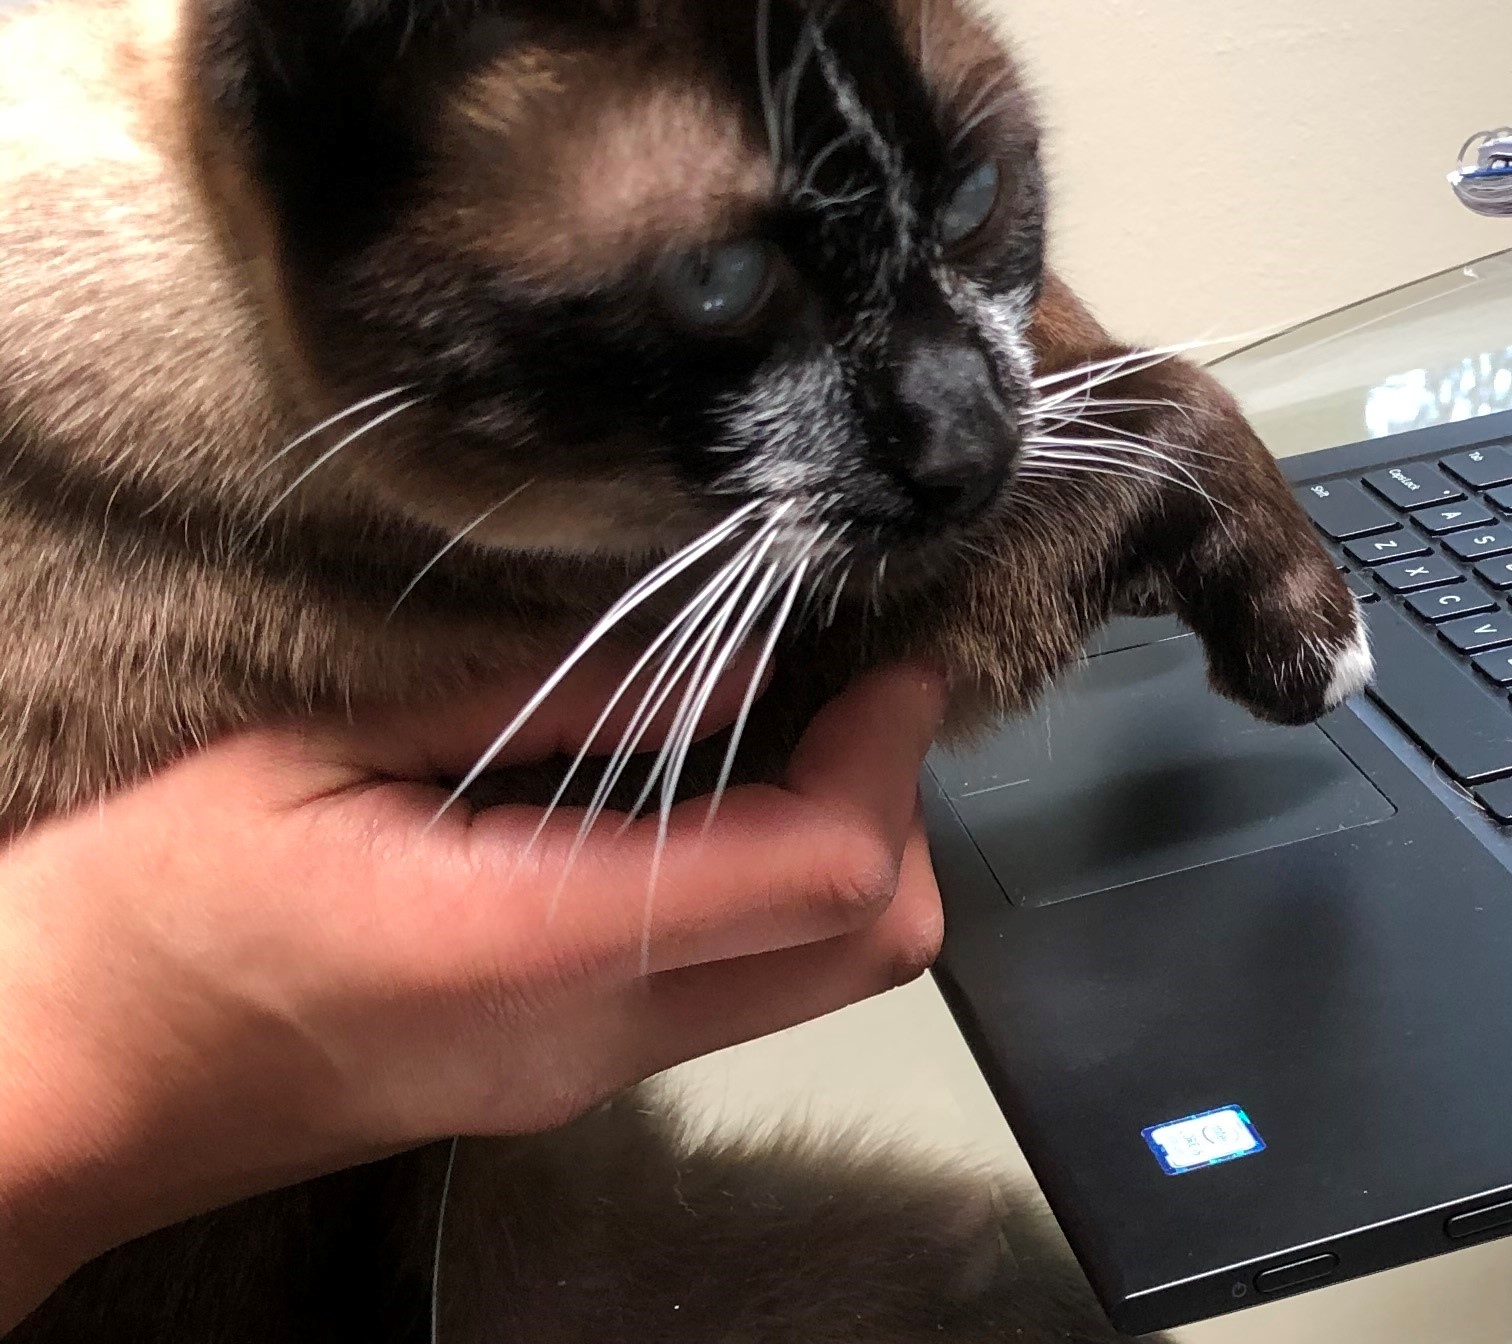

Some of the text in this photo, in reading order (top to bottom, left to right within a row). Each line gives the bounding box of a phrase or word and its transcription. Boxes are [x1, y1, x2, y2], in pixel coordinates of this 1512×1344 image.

[1441, 511, 1462, 520] A
[1374, 540, 1398, 550] Z
[1473, 535, 1496, 545] S
[1404, 566, 1430, 577] X
[1438, 595, 1461, 605] C
[1473, 623, 1498, 633] V
